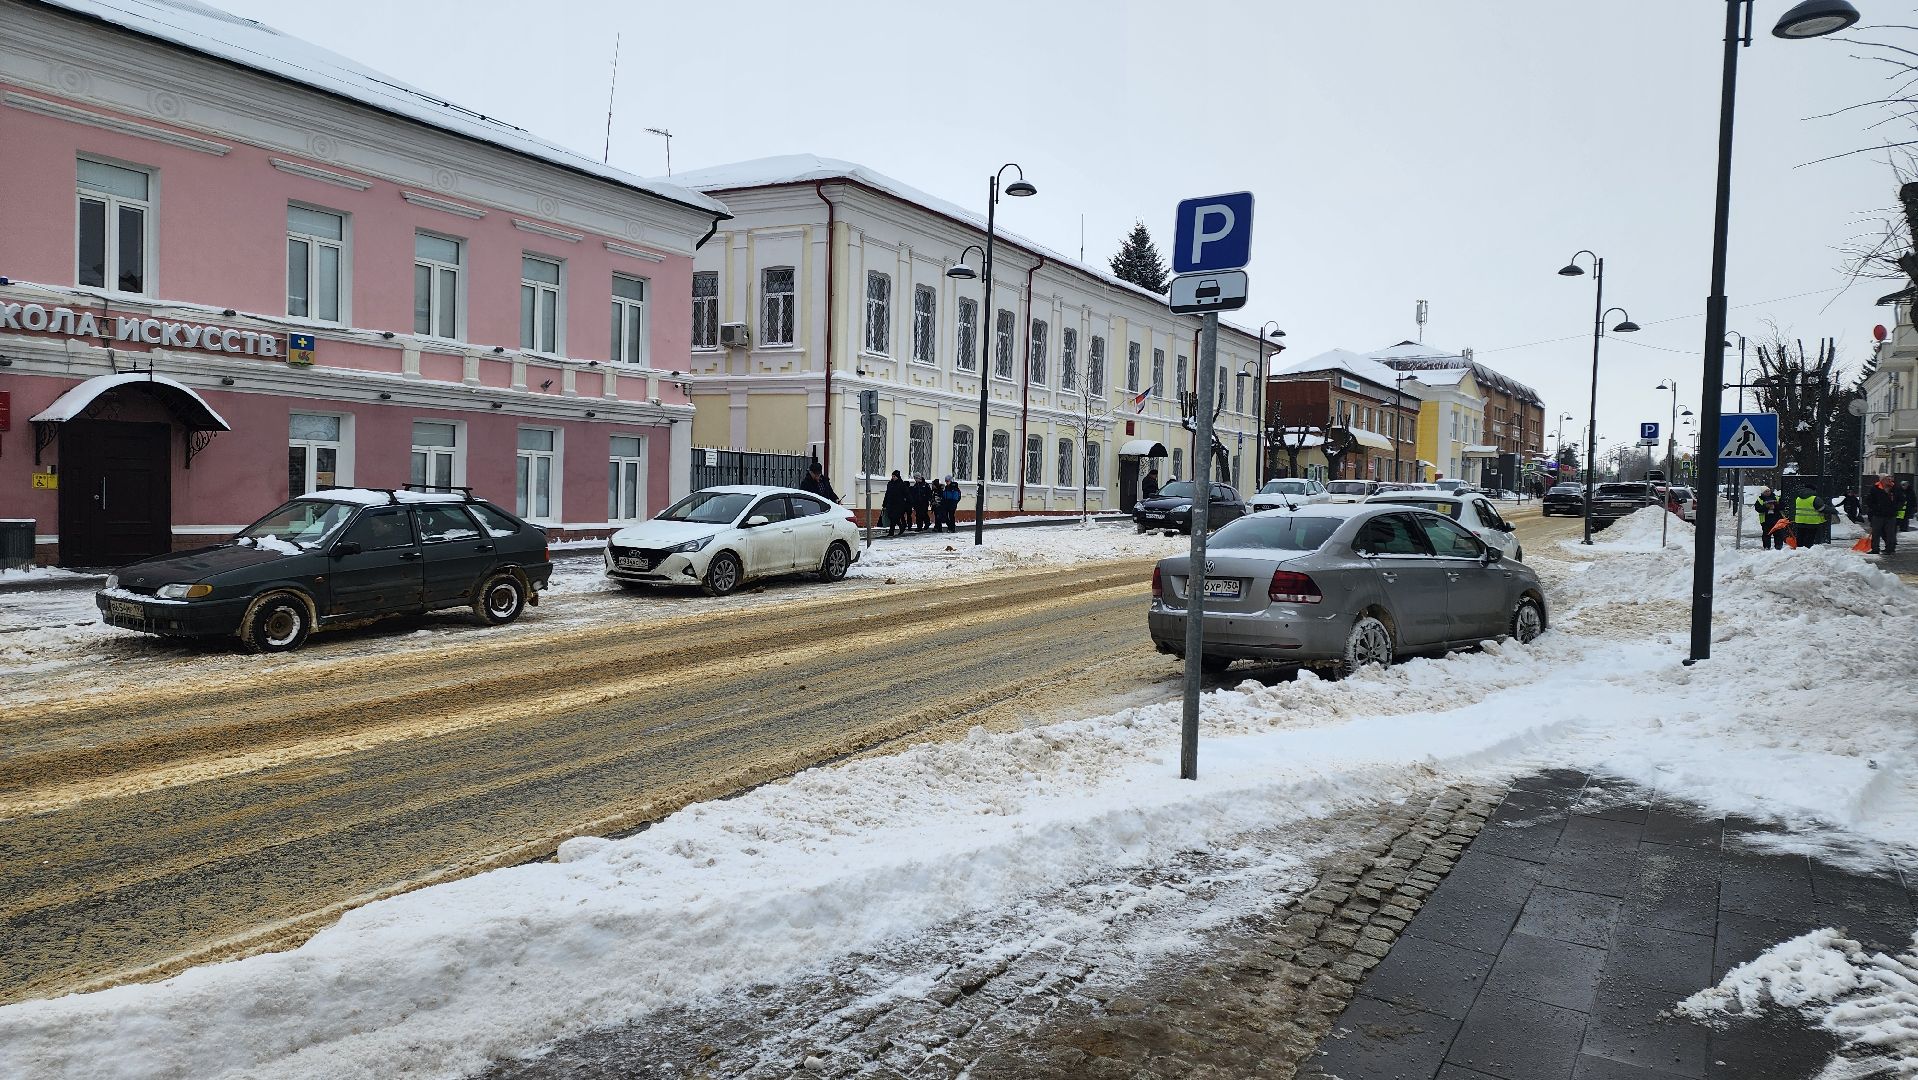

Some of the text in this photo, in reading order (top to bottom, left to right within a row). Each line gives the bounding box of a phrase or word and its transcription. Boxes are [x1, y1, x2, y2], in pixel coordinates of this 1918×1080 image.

[1192, 204, 1235, 264] P
[116, 316, 278, 357] ИСКУССТВ
[1645, 425, 1656, 436] P
[1223, 580, 1237, 590] 750
